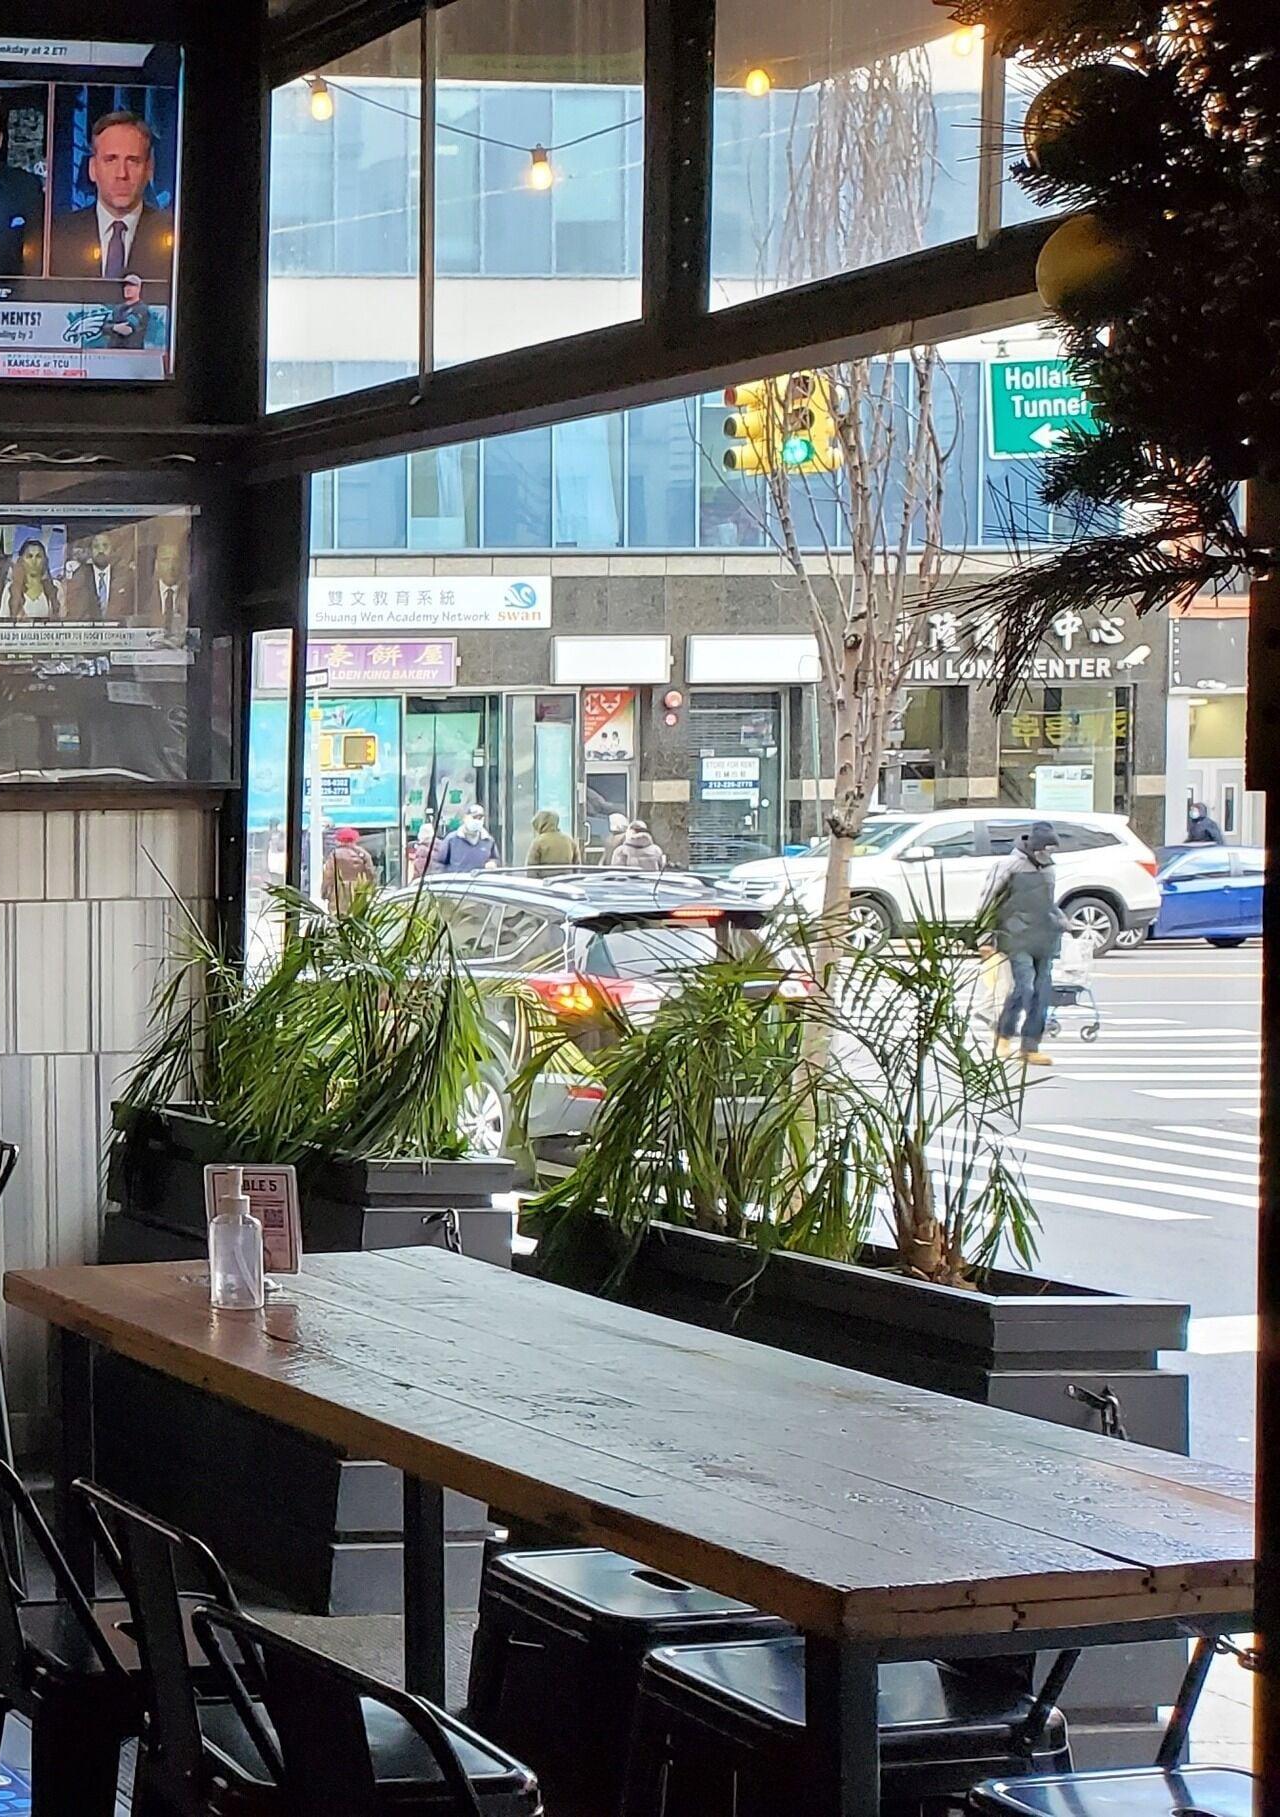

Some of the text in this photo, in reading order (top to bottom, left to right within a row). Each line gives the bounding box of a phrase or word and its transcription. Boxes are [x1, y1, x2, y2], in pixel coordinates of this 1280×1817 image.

[43, 46, 49, 55] 2
[18, 331, 26, 341] by
[7, 359, 41, 368] KANSAS
[53, 359, 69, 368] TCU
[315, 611, 490, 626] Shuang Wen Academy Network
[497, 611, 542, 621] swan
[331, 670, 360, 681] LDEN
[362, 670, 389, 681] KING
[391, 669, 438, 680] BAKERY
[268, 1180, 277, 1192] 5
